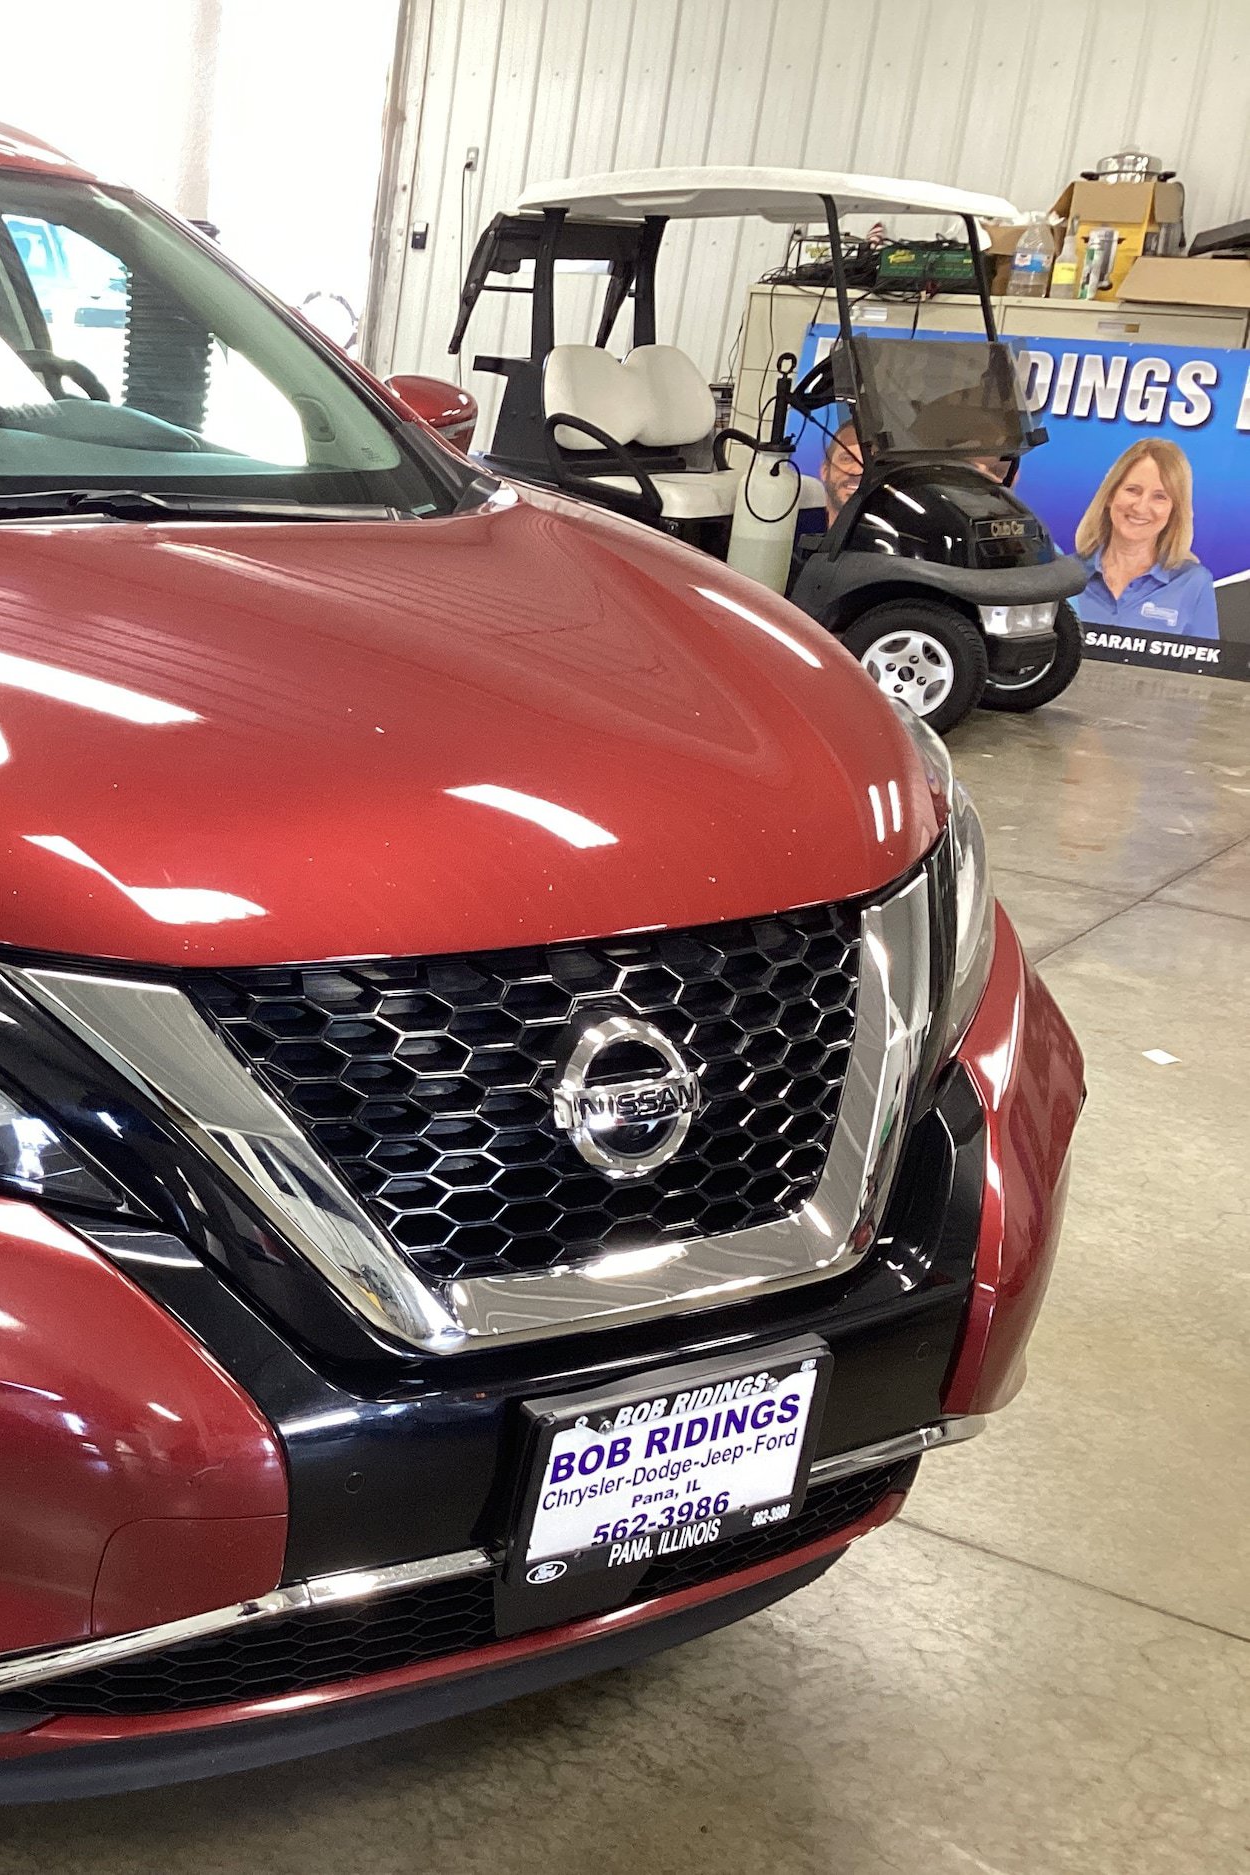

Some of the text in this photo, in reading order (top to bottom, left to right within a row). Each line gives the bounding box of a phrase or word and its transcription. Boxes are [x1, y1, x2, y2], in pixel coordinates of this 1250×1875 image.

[1015, 350, 1218, 427] DINGS
[1084, 631, 1221, 663] SARAH STUPEK
[577, 1081, 695, 1121] NISSAN
[614, 1372, 769, 1429] BOB RIDINGS
[550, 1394, 801, 1485] BOB RIDINGS
[631, 1480, 701, 1508] Pana, IL
[591, 1491, 730, 1546] 562-3986
[657, 1518, 722, 1555] ILLINOIS
